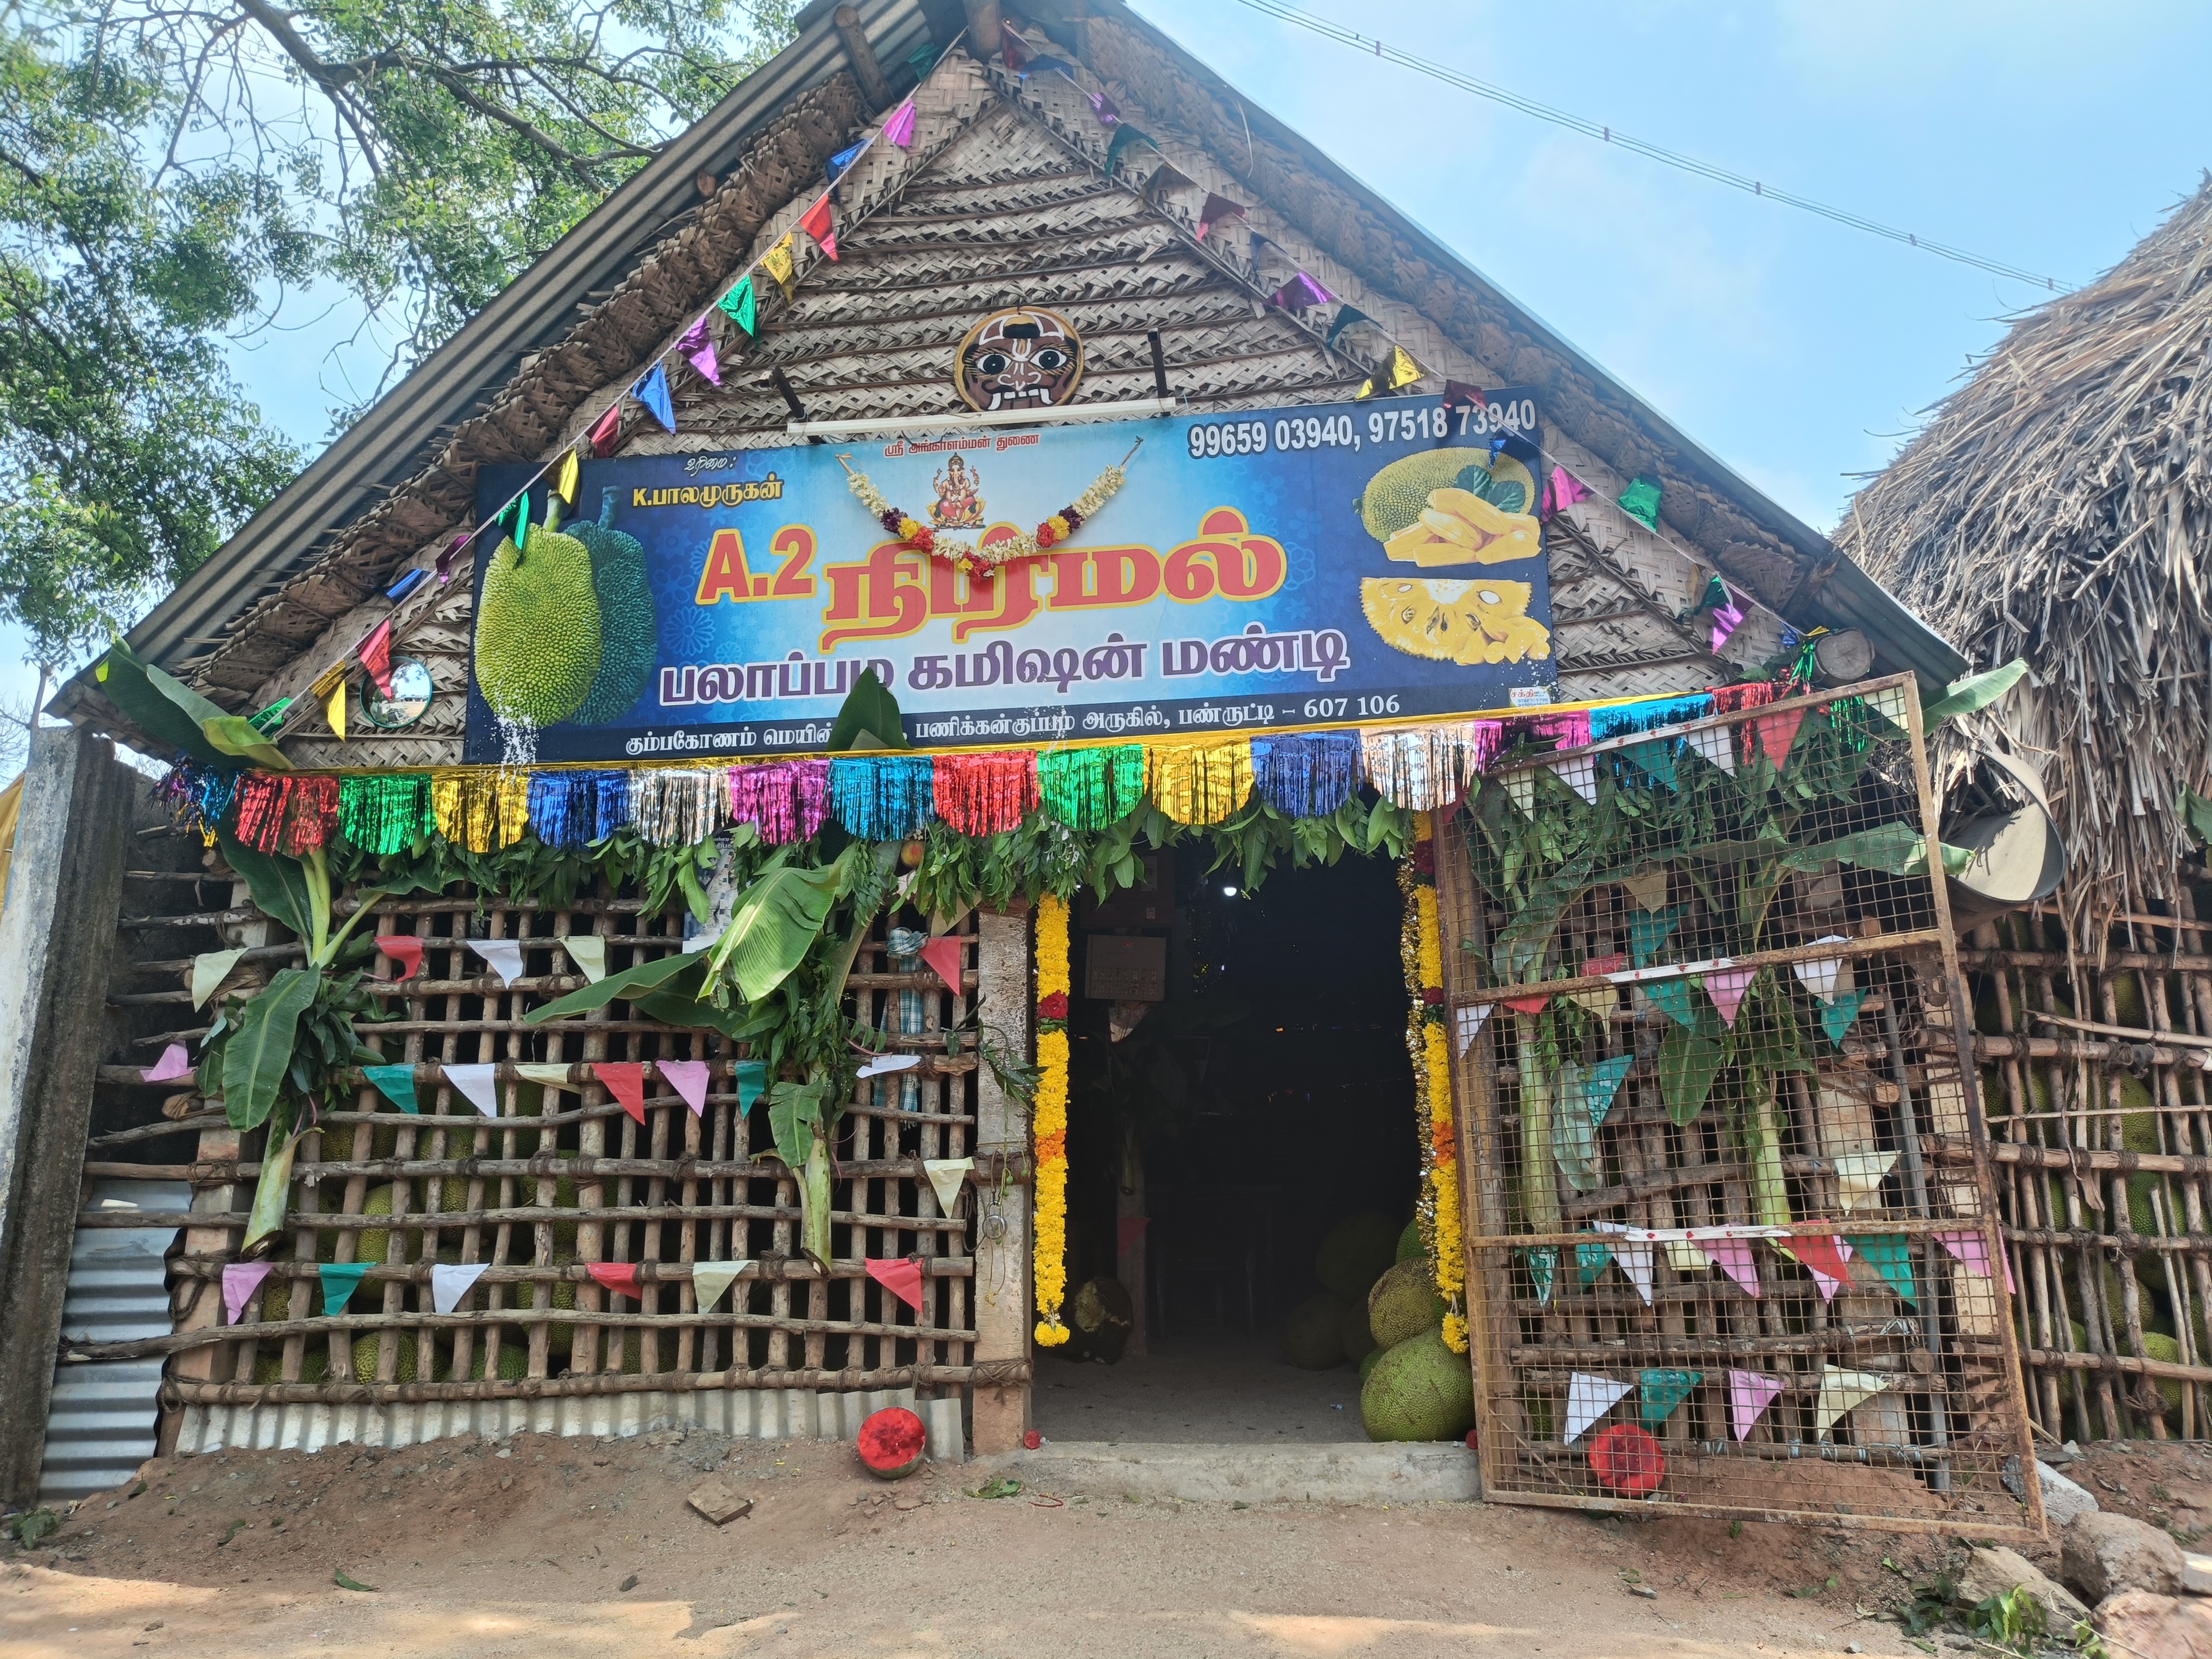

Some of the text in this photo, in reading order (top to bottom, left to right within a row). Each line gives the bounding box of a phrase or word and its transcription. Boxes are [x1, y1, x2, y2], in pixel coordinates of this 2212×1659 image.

[996, 434, 1039, 451] துணை
[1190, 399, 1536, 457] 99659 03940, 97518 73940
[632, 473, 784, 508] K.பாலமுருகன்
[696, 524, 817, 606] A.2
[908, 632, 1148, 693] கமிஷன்
[1161, 622, 1350, 681] மண்டி
[1511, 689, 1534, 698] சக்தி
[625, 726, 757, 755] கும்பகோணம்
[1083, 705, 1171, 732] அருகில்,
[1178, 702, 1275, 726] பண்ருட்டி
[1304, 697, 1348, 718] 607
[1357, 694, 1401, 716] 106
